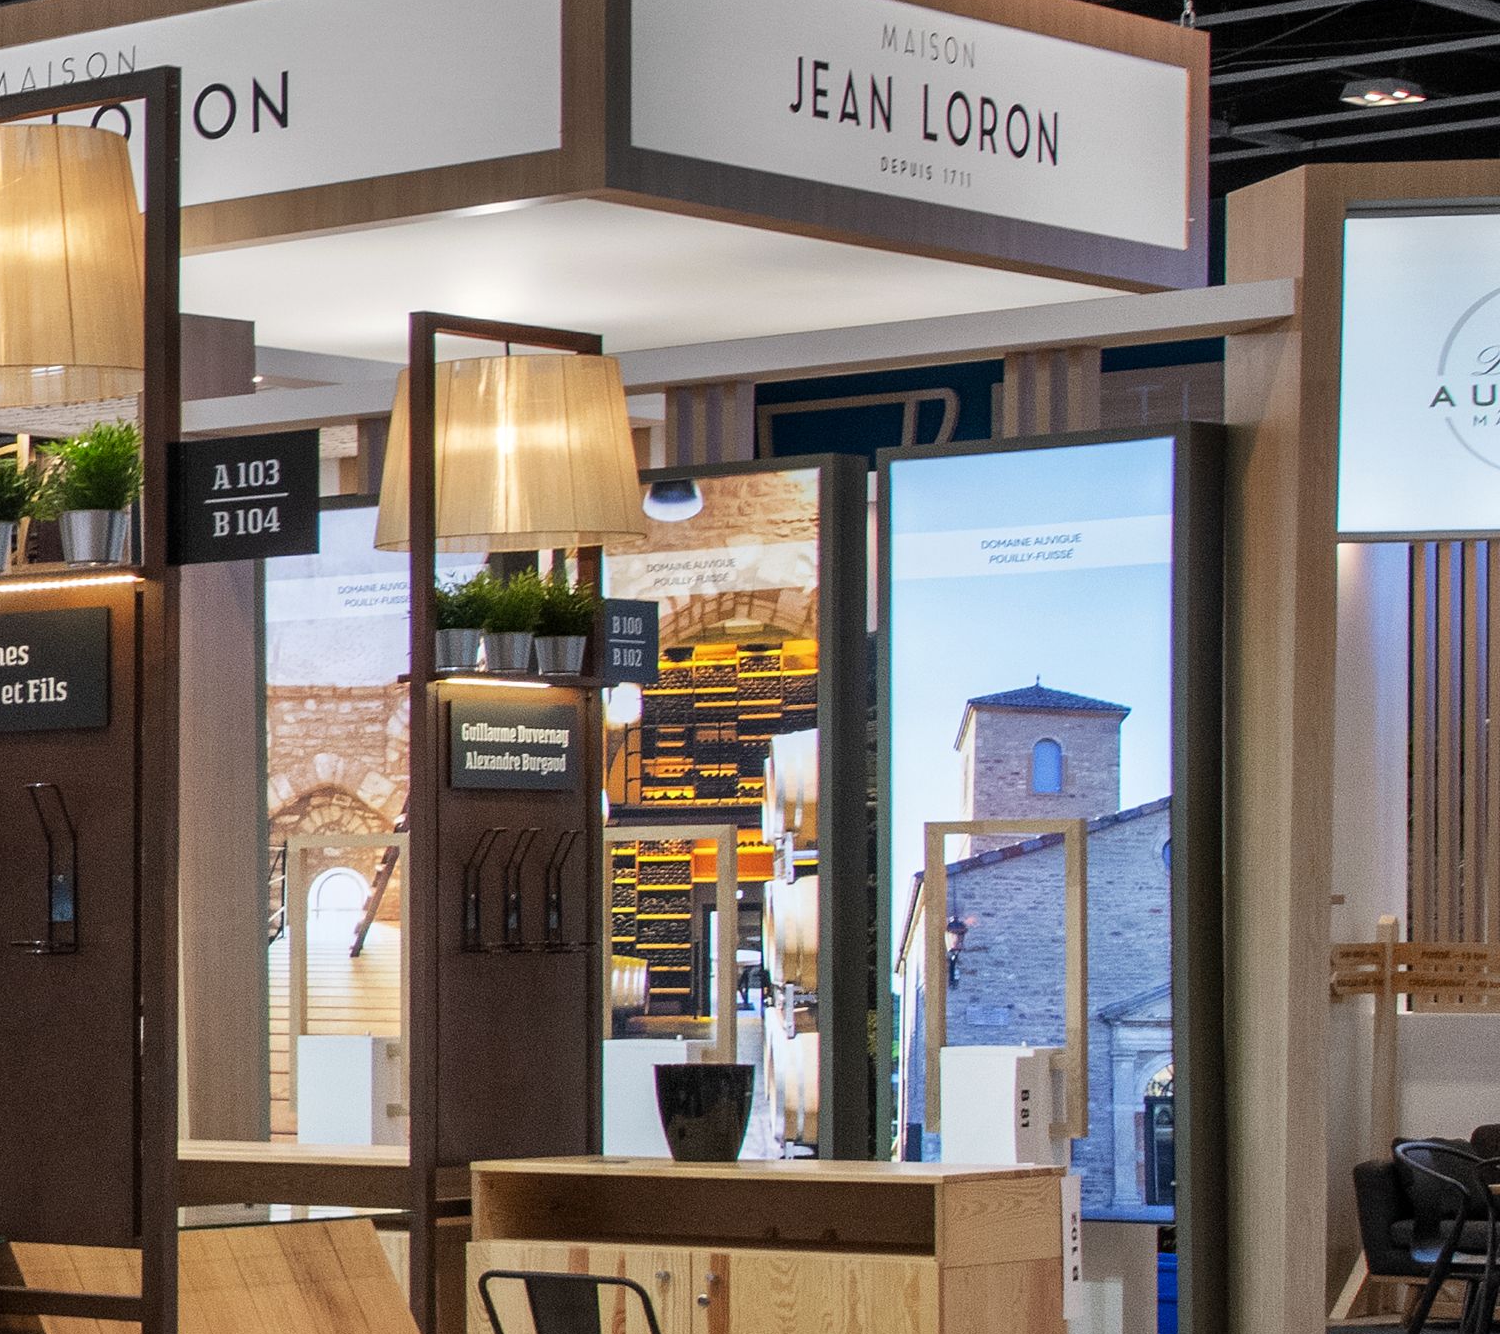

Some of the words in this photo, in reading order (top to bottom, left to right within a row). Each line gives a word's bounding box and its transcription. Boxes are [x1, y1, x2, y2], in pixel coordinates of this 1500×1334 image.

[881, 23, 975, 69] MAISON
[789, 56, 892, 134] JEAN
[922, 83, 1058, 166] LORON
[880, 156, 933, 180] DEPUIS
[943, 168, 972, 188] 1711
[212, 464, 232, 490] A
[236, 459, 280, 487] 103
[213, 511, 230, 537] B
[236, 507, 281, 535] 104
[980, 537, 1032, 549] DOMAINE
[612, 616, 621, 635] B
[612, 648, 621, 667] B
[623, 649, 642, 667] 102
[1, 682, 23, 704] et
[27, 677, 67, 703] Fils
[461, 723, 515, 744] Guillaume
[517, 726, 570, 748] Duvernay
[465, 752, 521, 772] Alexandre
[523, 753, 566, 775] Burgaud
